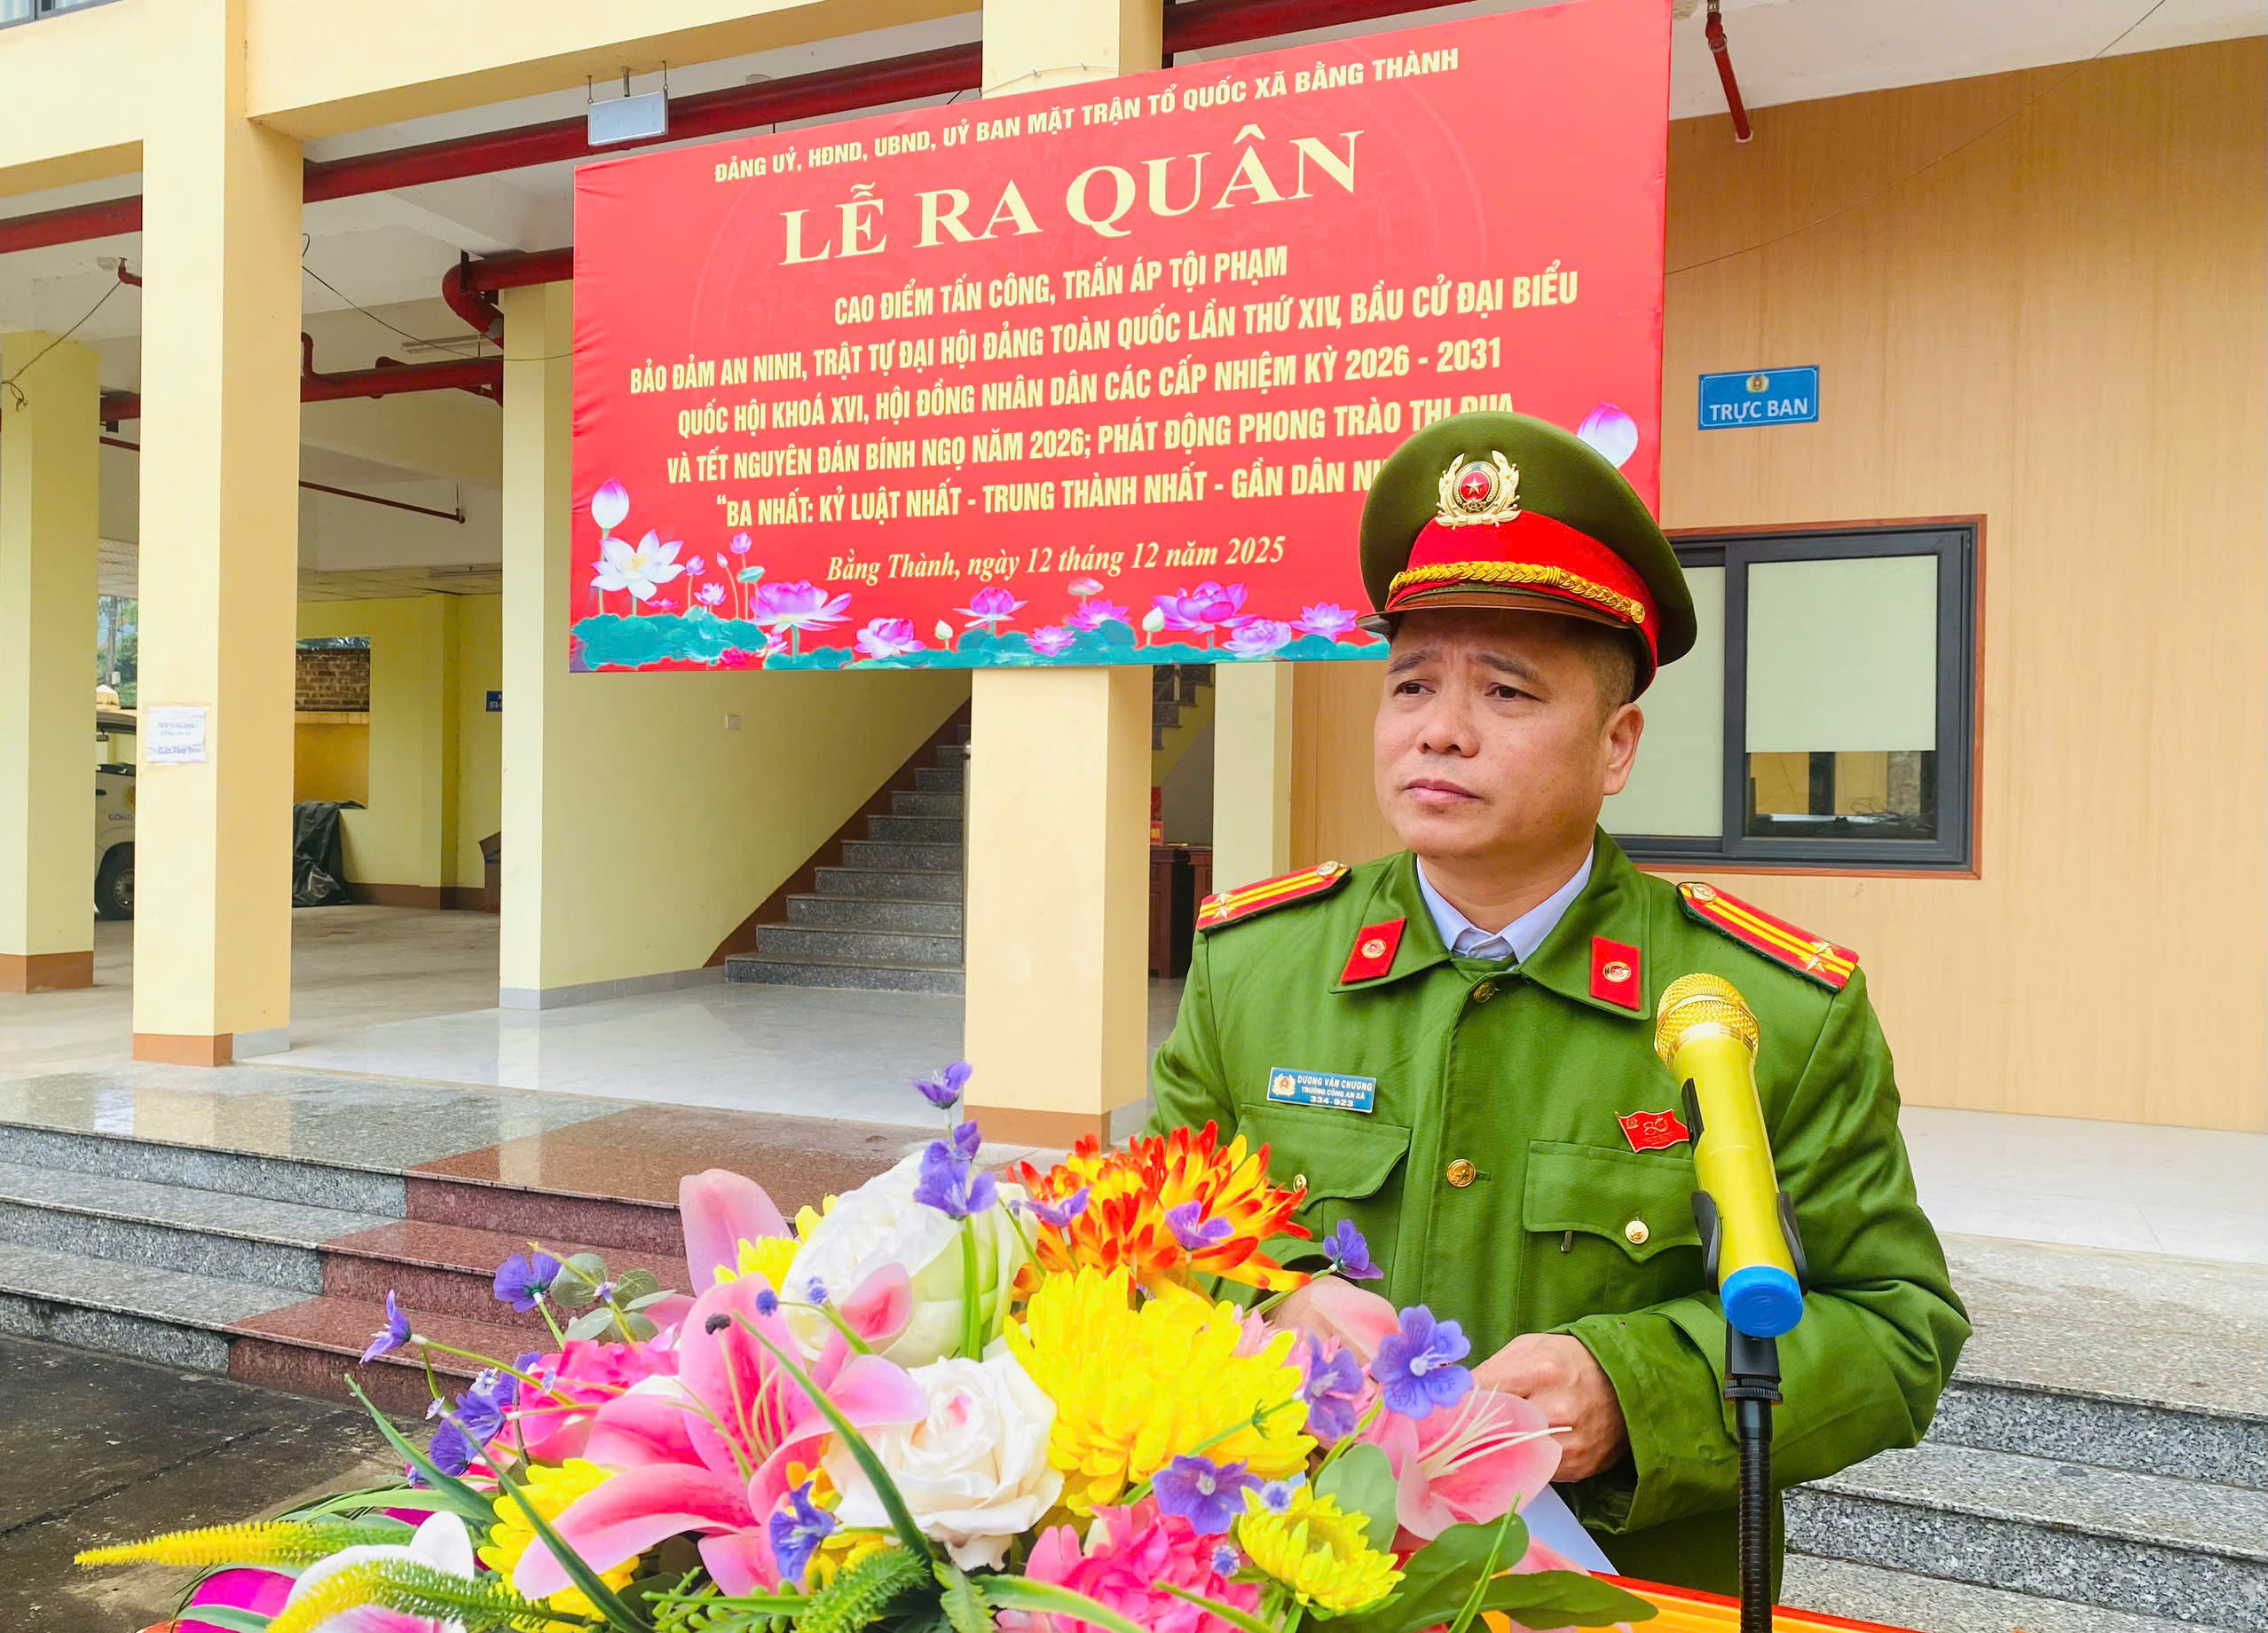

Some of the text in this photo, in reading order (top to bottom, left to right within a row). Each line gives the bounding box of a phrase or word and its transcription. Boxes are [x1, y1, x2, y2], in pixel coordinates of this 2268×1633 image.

[714, 47, 1459, 183] ĐẢNG UỶ, HĐND, UBND, UỶ BAN MẶT TRẬN TỔ QUỐC XÃ BẰNG THÀNH
[778, 120, 1365, 265] LỄ RA QUÂN
[630, 258, 1579, 394] BẢO ĐẢM AN NINH, TRẬT TỰ ĐẠI HỘI ĐẢNG TOÀN QUỐC LẦN THỨ XIV, BẦU CỬ ĐẠI BIỂU
[834, 245, 1288, 326] CAO ĐIỂM TẤN CÔNG, TRẤN ÁP TỘI PHẠM
[678, 336, 1500, 439] QUỐC HỘI KHOÁ XVI, HỘI ĐỒNG NHÂN DÂN CÁC CẤP NHIỆM KỲ 2026 - 2031
[1709, 398, 1808, 423] TRỰC BAN
[666, 451, 692, 484] VÀ
[696, 446, 728, 482] TẾT
[734, 443, 812, 479] NGUYÊN
[816, 439, 860, 474] ĐÁN
[865, 436, 916, 471] BÍNH
[921, 436, 966, 471] NGỌ
[972, 427, 1023, 463] NĂM
[1028, 427, 1091, 460] 2026;
[1098, 415, 1159, 454] PHÁT
[1163, 411, 1232, 455] ĐỘNG
[1239, 407, 1326, 445] PHONG
[1333, 397, 1402, 438] TRÀO
[758, 486, 814, 526] NHẤT:
[819, 485, 846, 523] KỶ
[851, 485, 902, 525] LUẬT
[906, 477, 962, 518] NHẤT
[982, 481, 1055, 514] TRUNG
[1060, 471, 1138, 509] THÀNH
[1144, 461, 1208, 504] NHẤT
[1231, 456, 1284, 500] GẦN
[1291, 456, 1345, 495] DÂN
[826, 535, 1286, 587] Bằng Thành, ngày 12 tháng 12 năm 2025
[1297, 1075, 1323, 1086] DƯƠNG
[1341, 1079, 1373, 1092] CHƯƠNG
[1310, 1095, 1354, 1107] 334-923
